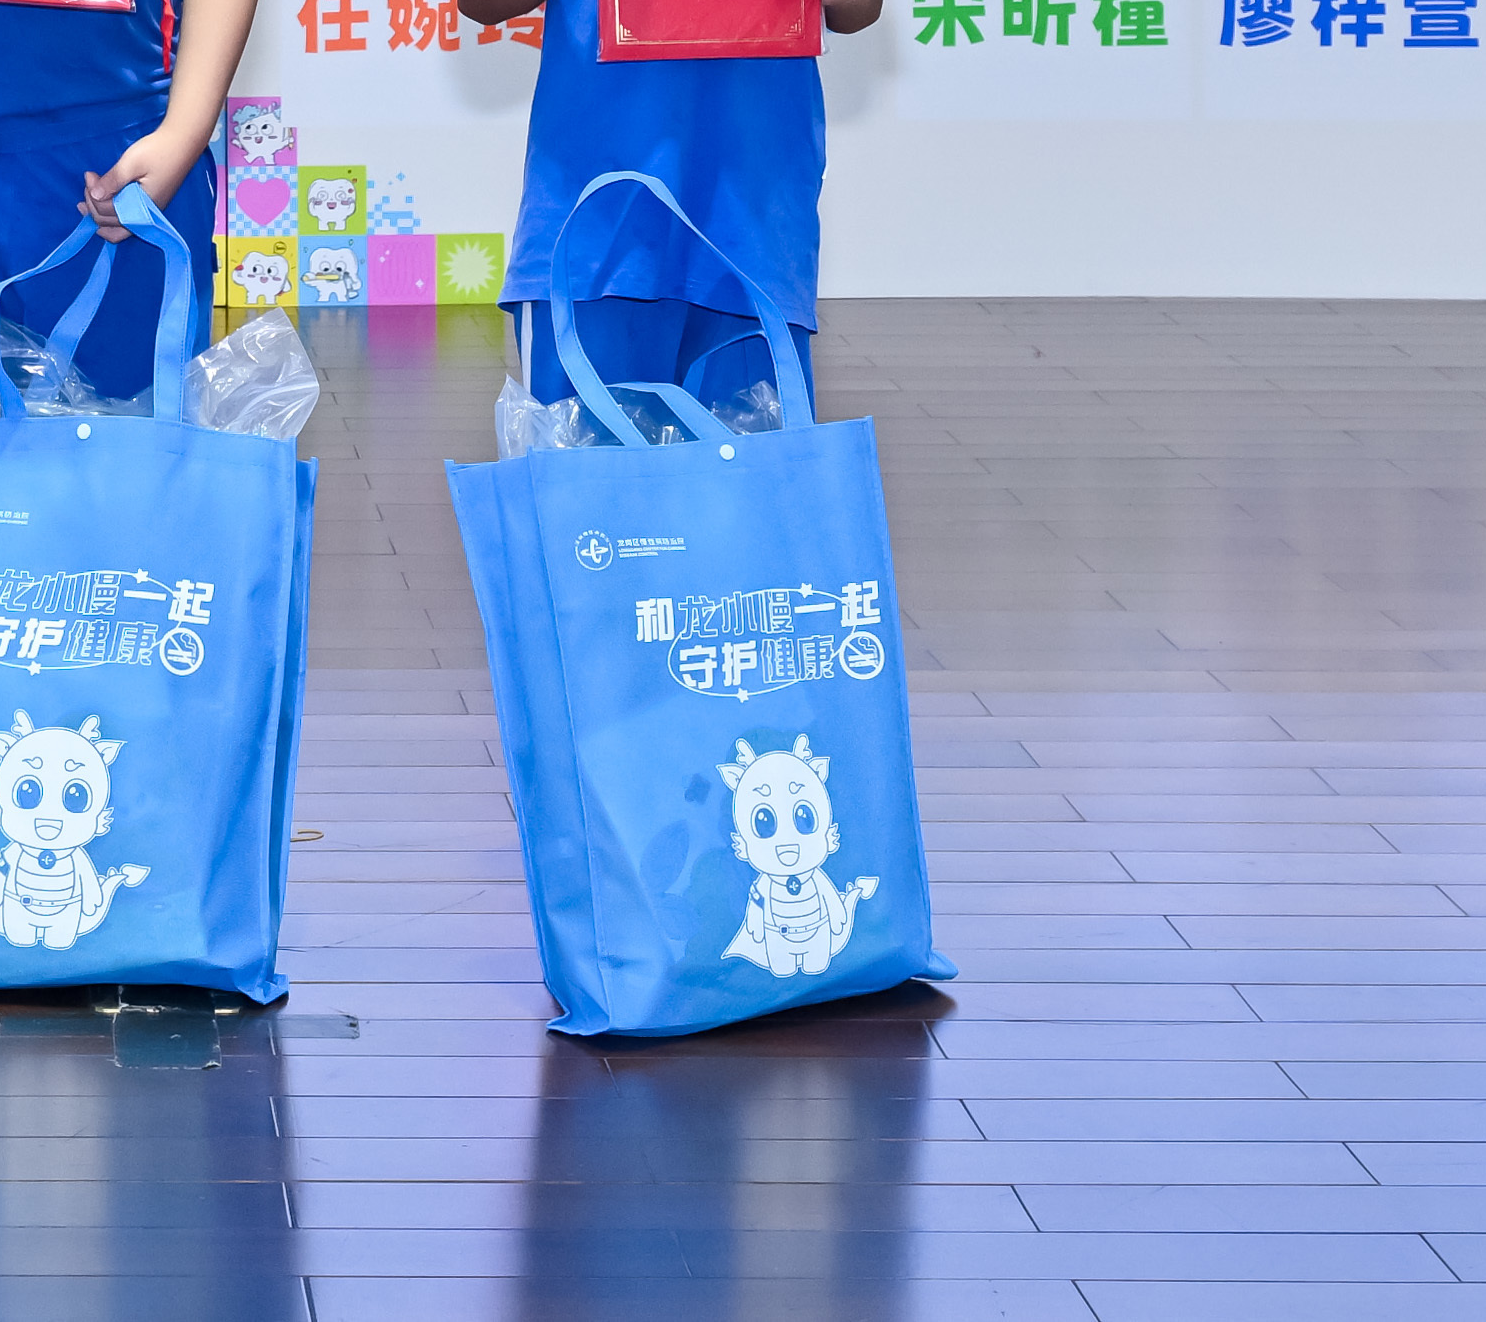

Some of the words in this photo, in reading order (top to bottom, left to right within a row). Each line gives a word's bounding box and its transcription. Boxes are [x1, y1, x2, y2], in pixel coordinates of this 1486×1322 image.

[635, 580, 882, 643] 和龙小慢一起
[679, 634, 835, 689] 守护健康
